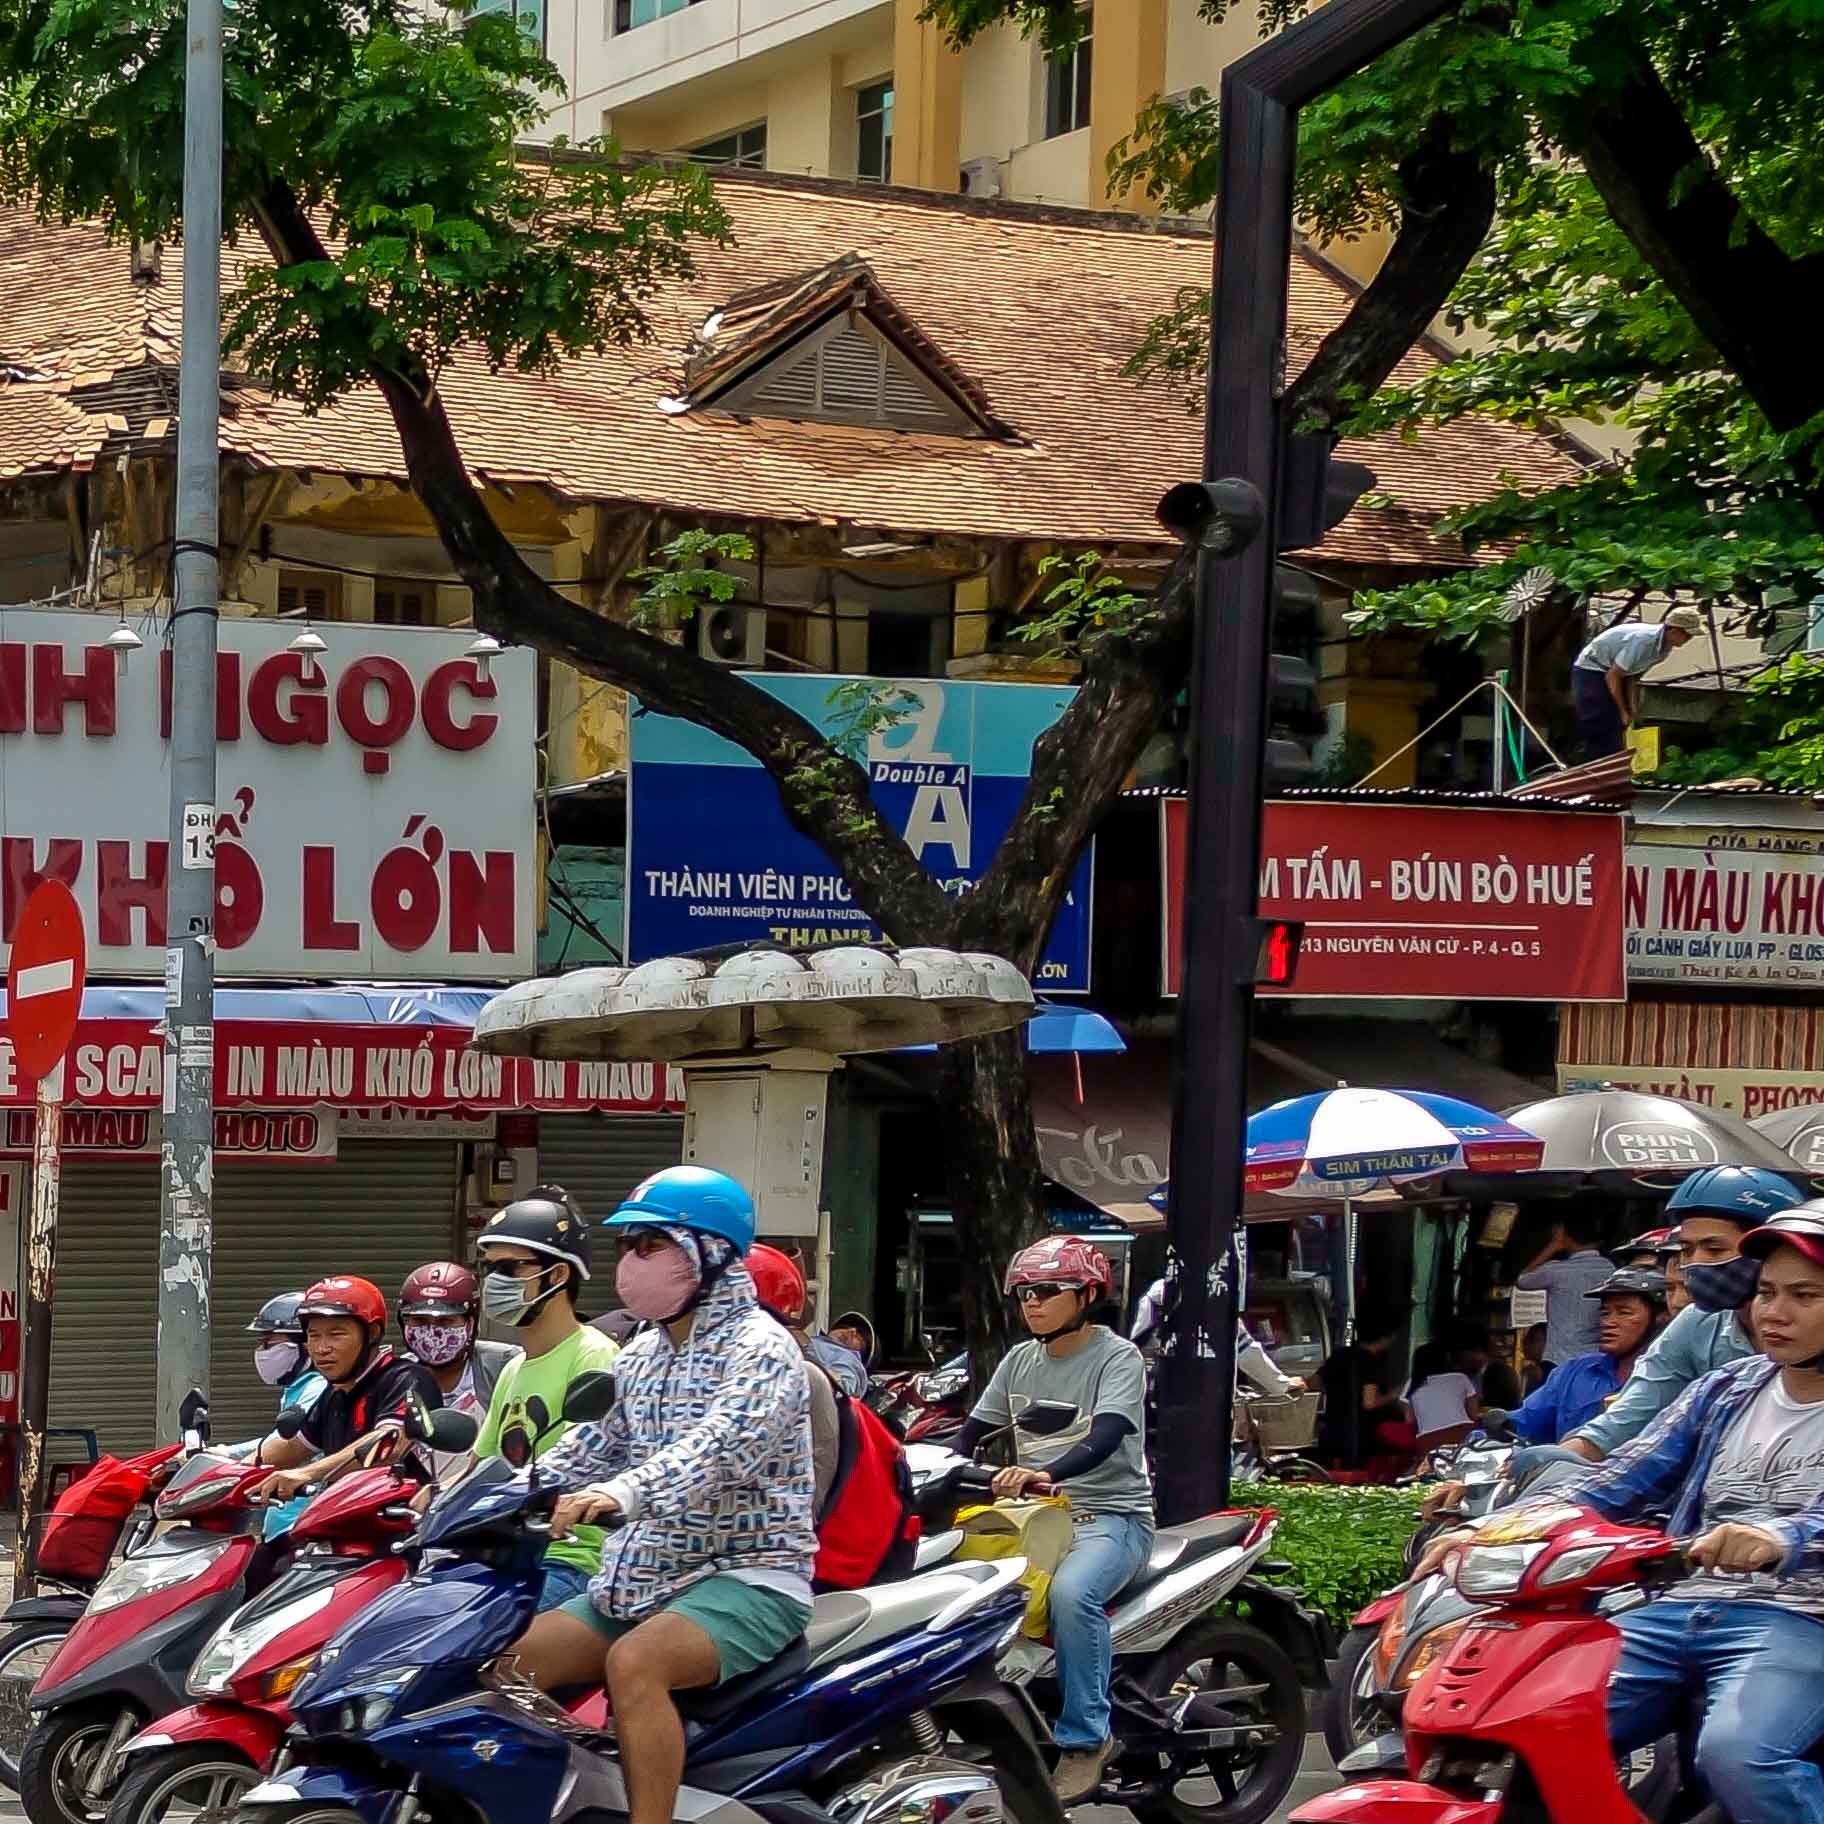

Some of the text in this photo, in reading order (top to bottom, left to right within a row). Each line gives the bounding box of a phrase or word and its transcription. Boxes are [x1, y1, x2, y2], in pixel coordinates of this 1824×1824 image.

[874, 764, 966, 785] Double A
[186, 813, 214, 827] ĐH
[302, 814, 516, 953] LỚN
[646, 864, 852, 902] THÀNH VIÊN PHO
[1286, 845, 1362, 900] TẤM
[1391, 852, 1462, 902] BÚN
[1471, 854, 1519, 903] BÒ
[1527, 853, 1594, 906] HUẾ
[1625, 852, 1824, 937] N MÀU KH
[689, 905, 731, 917] DOANH
[1326, 937, 1395, 954] NGUYỄN
[1398, 937, 1432, 954] VĂN
[75, 1045, 163, 1098] SCA
[227, 1045, 265, 1097] IN
[278, 1037, 353, 1099] MÀU
[365, 1030, 433, 1098] KHỔ
[214, 1111, 319, 1150] HOTO
[1617, 1133, 1694, 1148] PHIN
[1623, 1148, 1700, 1162] DELI
[1325, 1160, 1360, 1176] SIM
